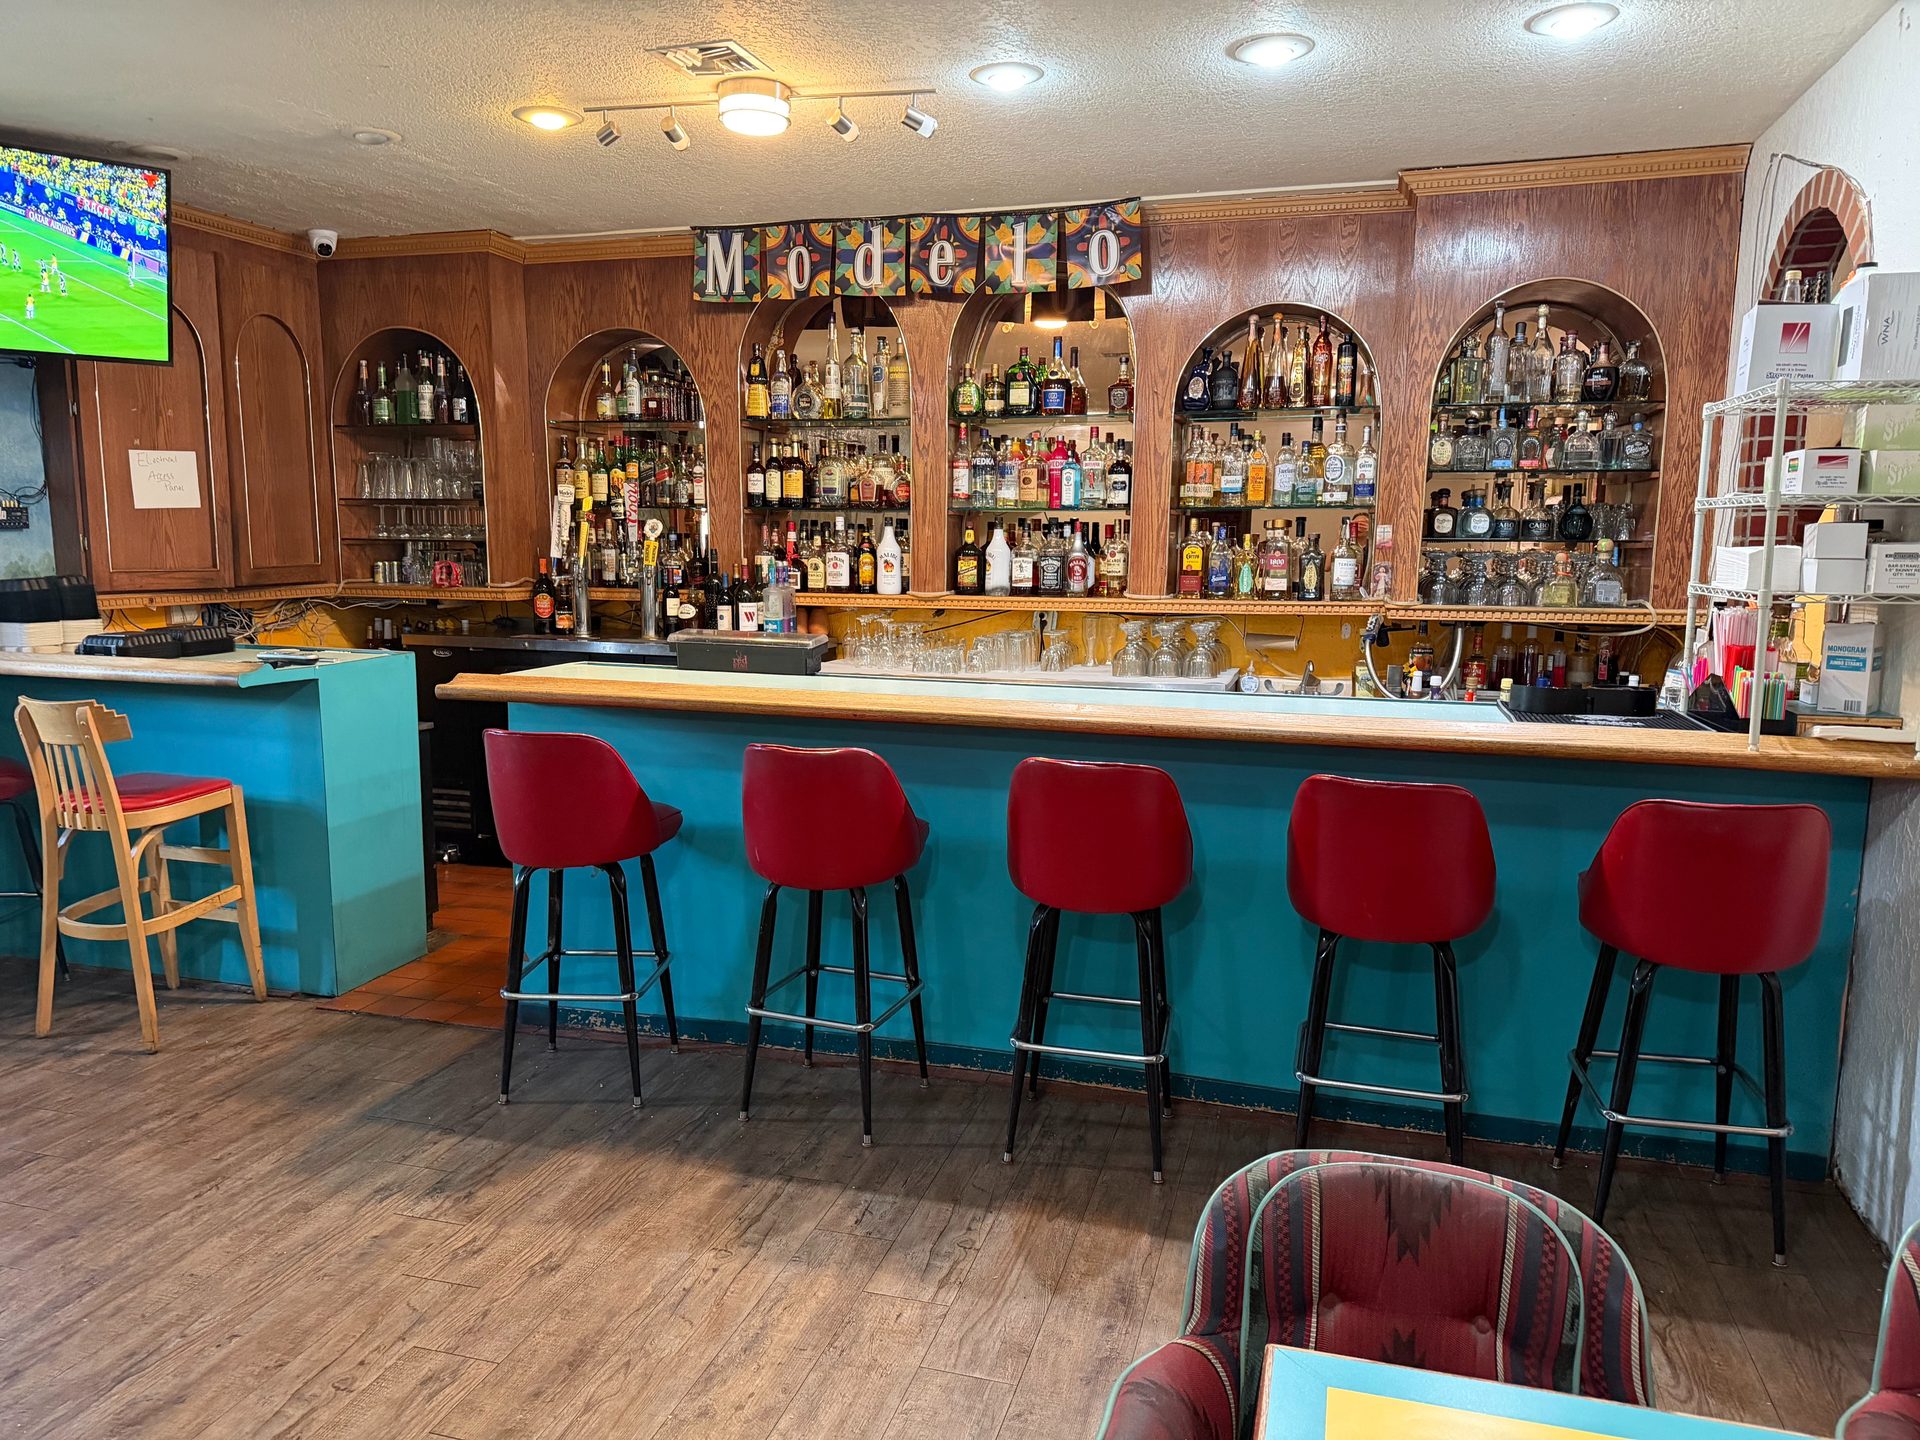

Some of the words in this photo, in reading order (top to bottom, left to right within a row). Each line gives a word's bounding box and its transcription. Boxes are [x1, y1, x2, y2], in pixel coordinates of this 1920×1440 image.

[29, 211, 48, 226] QATAR
[51, 219, 76, 237] AIRWAYS
[96, 237, 113, 253] VISA
[705, 222, 1121, 297] Modelo
[1881, 317, 1890, 345] WNA
[148, 470, 175, 482] Access
[163, 480, 185, 492] Panel
[626, 481, 639, 524] Coors
[1828, 645, 1867, 653] MONOGRAM
